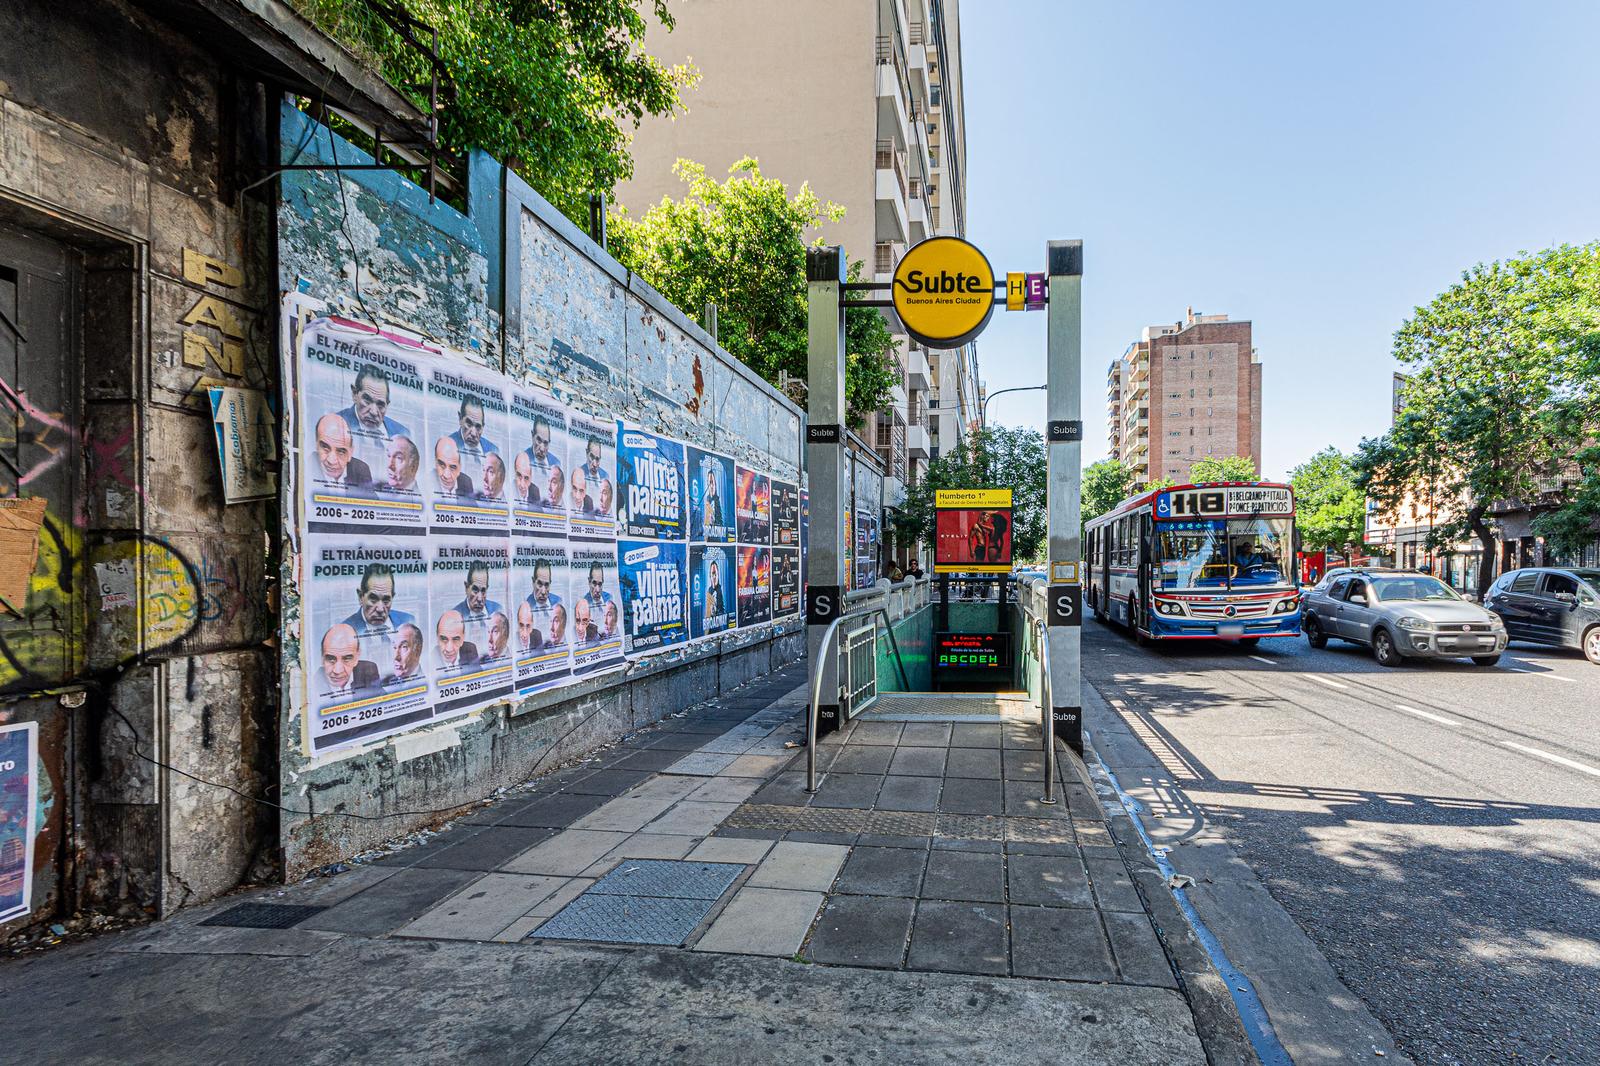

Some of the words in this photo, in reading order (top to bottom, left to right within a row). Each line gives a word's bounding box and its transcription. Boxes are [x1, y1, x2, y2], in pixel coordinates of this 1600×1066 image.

[906, 270, 981, 294] Subte
[1011, 280, 1022, 295] H
[1031, 280, 1041, 295] E
[308, 346, 351, 370] PODER
[317, 334, 330, 348] EL
[333, 338, 398, 370] TRIÁNGULO
[400, 361, 418, 376] DEL
[428, 382, 457, 399] PODER
[434, 371, 444, 382] EL
[444, 374, 490, 396] TRIÁNGULO
[491, 389, 504, 400] DEL
[811, 428, 834, 438] Subte
[1054, 426, 1078, 435] Subte
[634, 450, 678, 493] vilma
[628, 484, 678, 522] palma
[1172, 493, 1224, 514] 118
[316, 507, 342, 518] 2006
[352, 508, 375, 520] 2026
[436, 514, 454, 523] 2006
[461, 516, 476, 524] 2026
[322, 550, 336, 560] EL
[339, 546, 402, 560] TRIÁNGULO
[404, 550, 422, 560] DEL
[439, 548, 448, 558] EL
[450, 546, 494, 558] TRIÁNGULO
[496, 549, 508, 558] DEL
[556, 548, 566, 556] DEL
[314, 564, 356, 576] PODER
[432, 560, 464, 570] PODER
[636, 562, 680, 598] vilma
[694, 574, 700, 592] 6
[815, 595, 830, 616] S
[1056, 596, 1073, 616] S
[632, 595, 680, 636] palma
[440, 688, 460, 698] 2006
[466, 682, 482, 692] 2026
[322, 715, 348, 730] 2006
[358, 706, 382, 720] 2026
[1052, 713, 1076, 721] Subte
